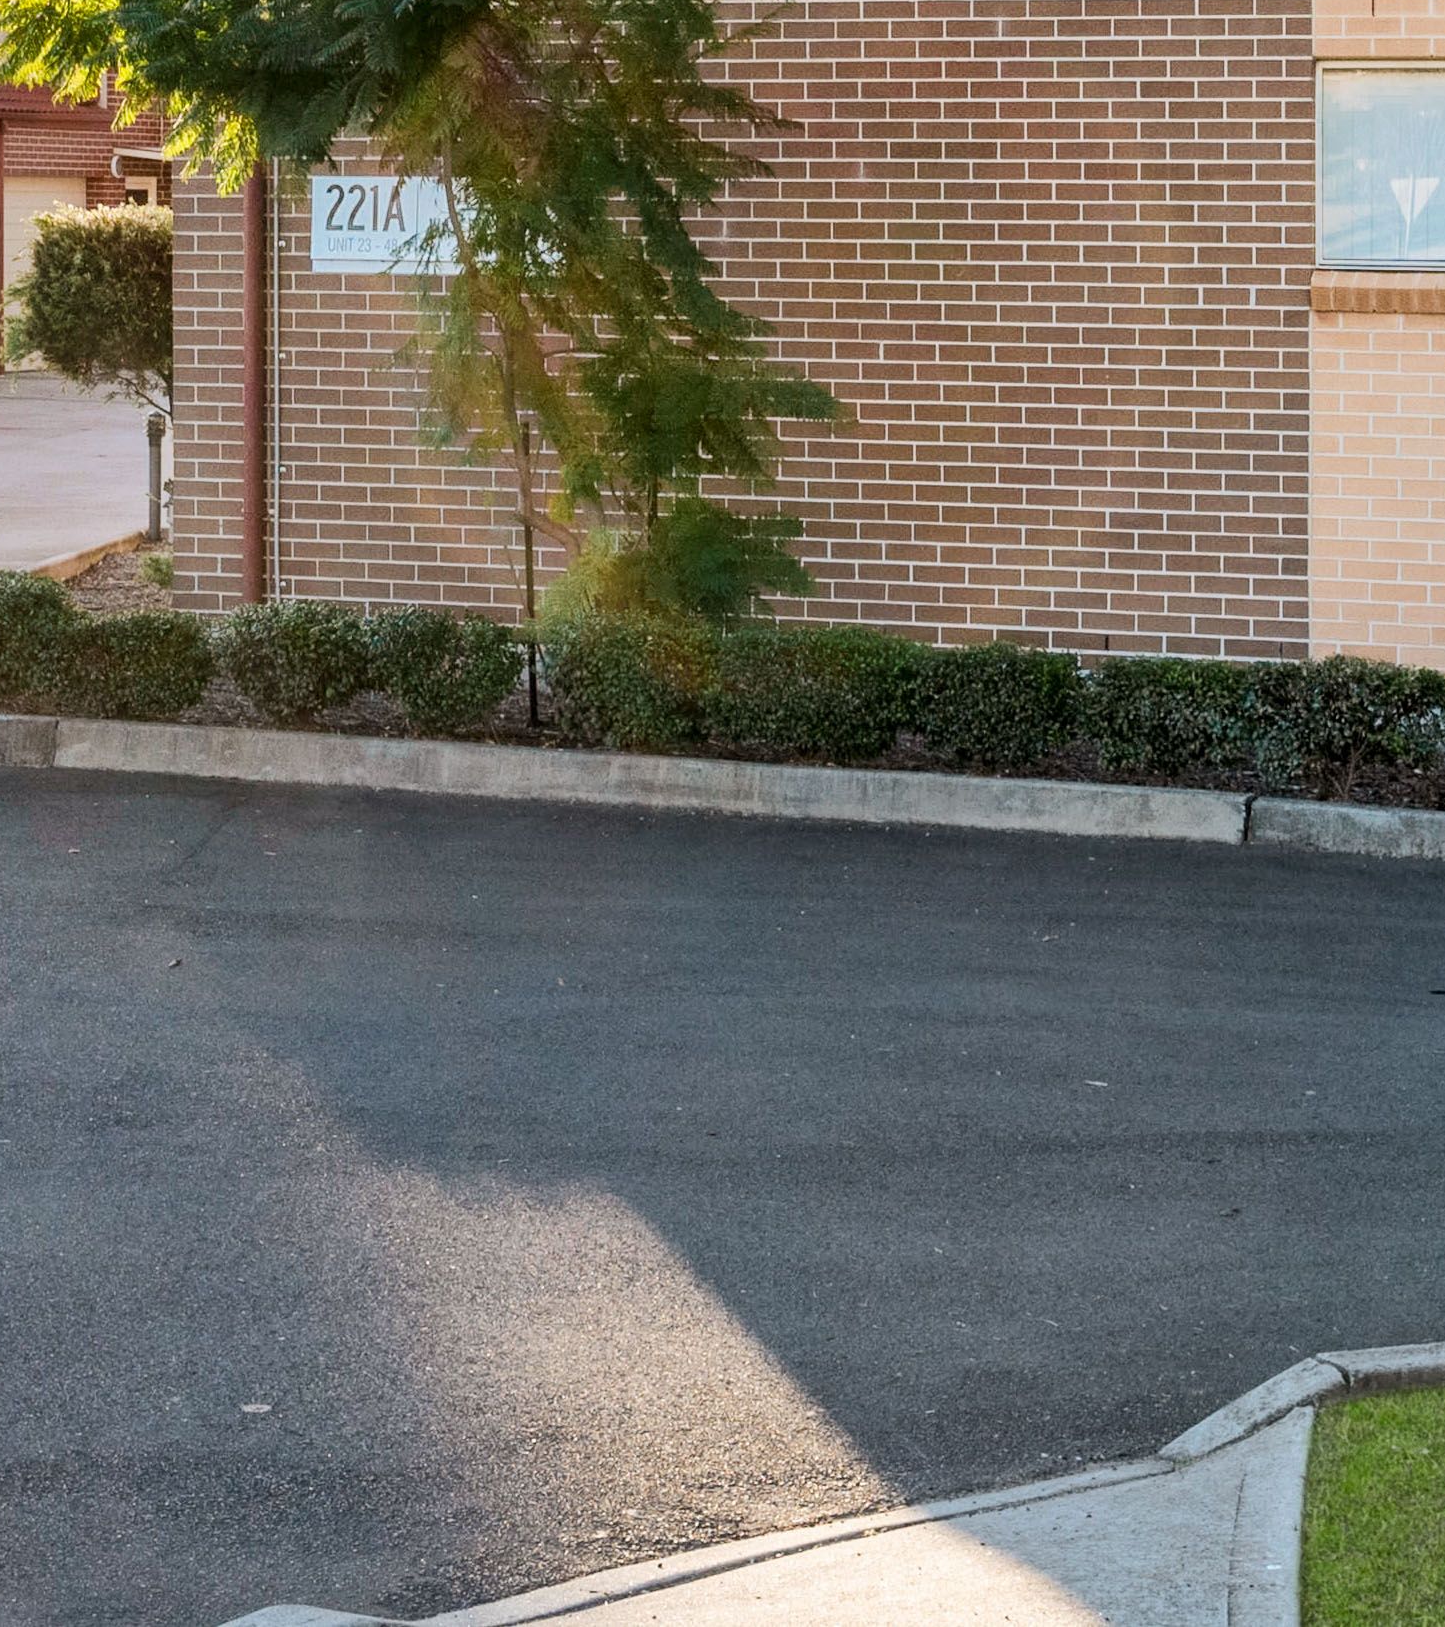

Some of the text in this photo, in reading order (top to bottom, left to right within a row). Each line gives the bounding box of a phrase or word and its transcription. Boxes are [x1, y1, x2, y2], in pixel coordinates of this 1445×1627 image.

[326, 184, 406, 232] 221A
[328, 237, 355, 252] UNIT
[357, 237, 372, 253] 23
